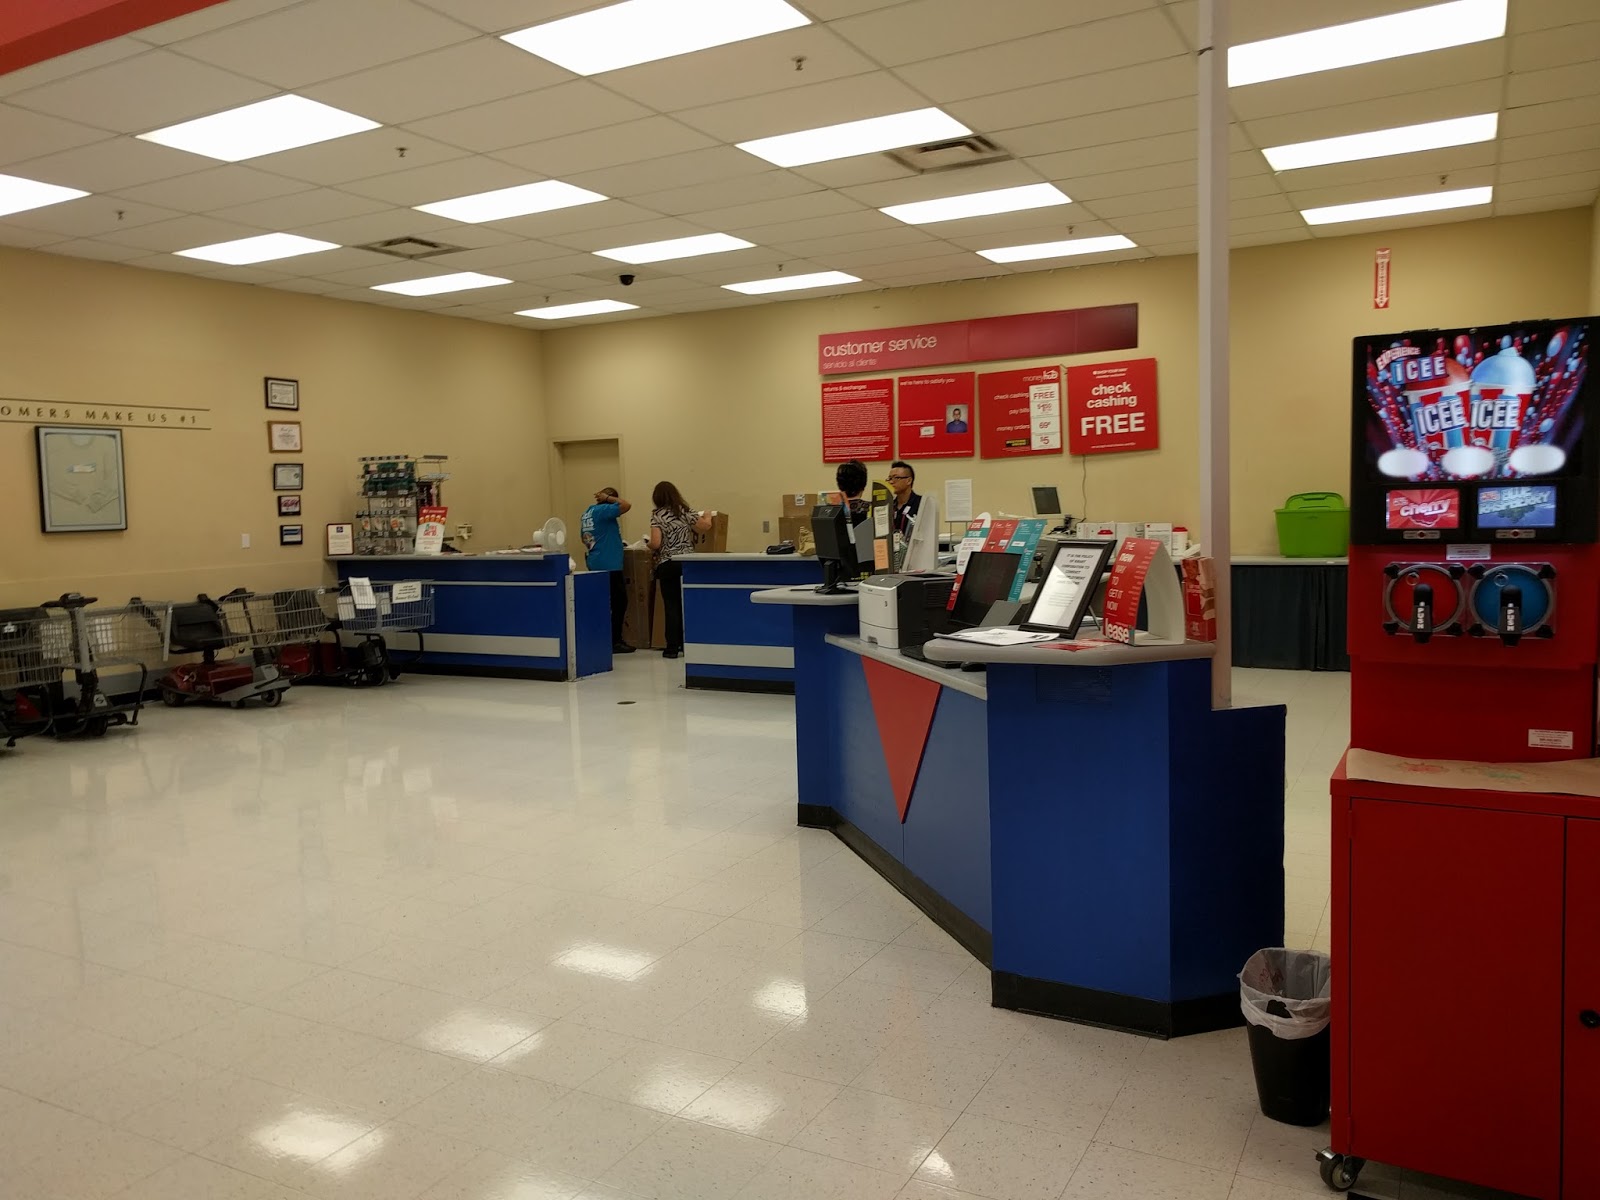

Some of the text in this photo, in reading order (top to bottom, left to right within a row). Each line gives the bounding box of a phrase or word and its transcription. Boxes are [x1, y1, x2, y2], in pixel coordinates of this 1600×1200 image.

[823, 334, 937, 357] customer service
[823, 358, 877, 370] servicio al cliente
[1395, 356, 1446, 382] ICEE
[1033, 391, 1055, 400] FREE
[1091, 381, 1132, 396] check
[1086, 394, 1137, 409] cashing
[85, 409, 134, 422] MAKE
[147, 412, 167, 423] US
[1081, 411, 1146, 437] FREE
[1415, 398, 1467, 436] ICEE
[1470, 398, 1521, 430] ICEE
[1400, 498, 1451, 517] cherry
[1119, 552, 1135, 563] new
[1417, 607, 1425, 630] PUSH
[1506, 608, 1515, 632] PUSH
[1105, 617, 1130, 644] lease
